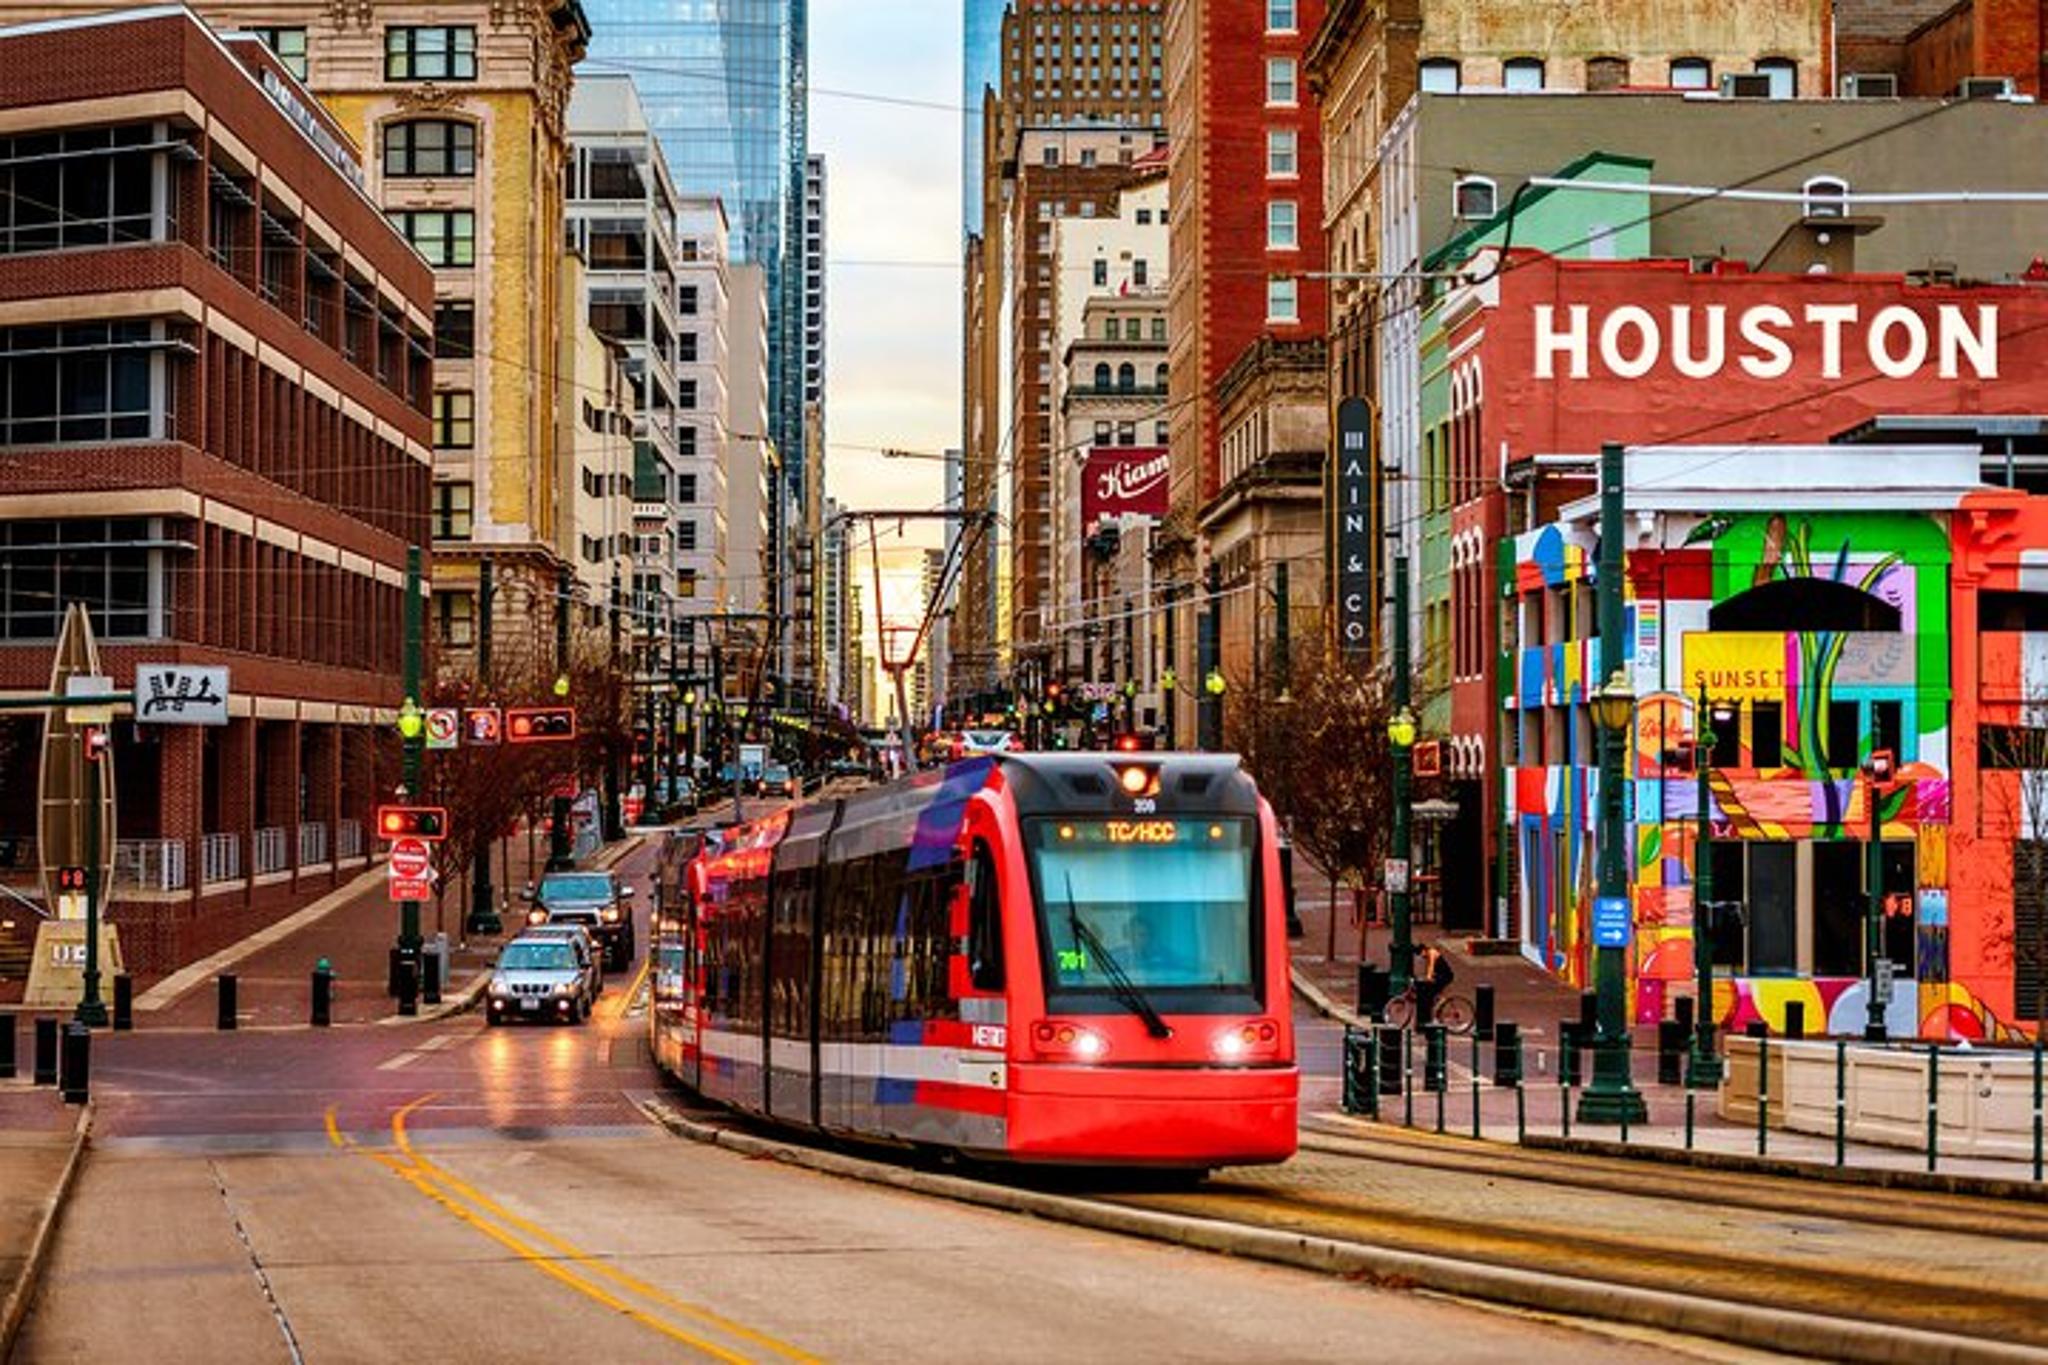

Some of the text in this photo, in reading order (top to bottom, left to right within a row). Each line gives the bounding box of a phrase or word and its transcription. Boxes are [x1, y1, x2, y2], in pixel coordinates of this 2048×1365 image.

[1533, 304, 1999, 379] HOUSTON
[1097, 454, 1170, 499] Kiam
[1347, 554, 1364, 573] &
[1345, 593, 1364, 641] CO
[1694, 669, 1784, 689] SUNSET
[1107, 821, 1175, 841] TC/HCC
